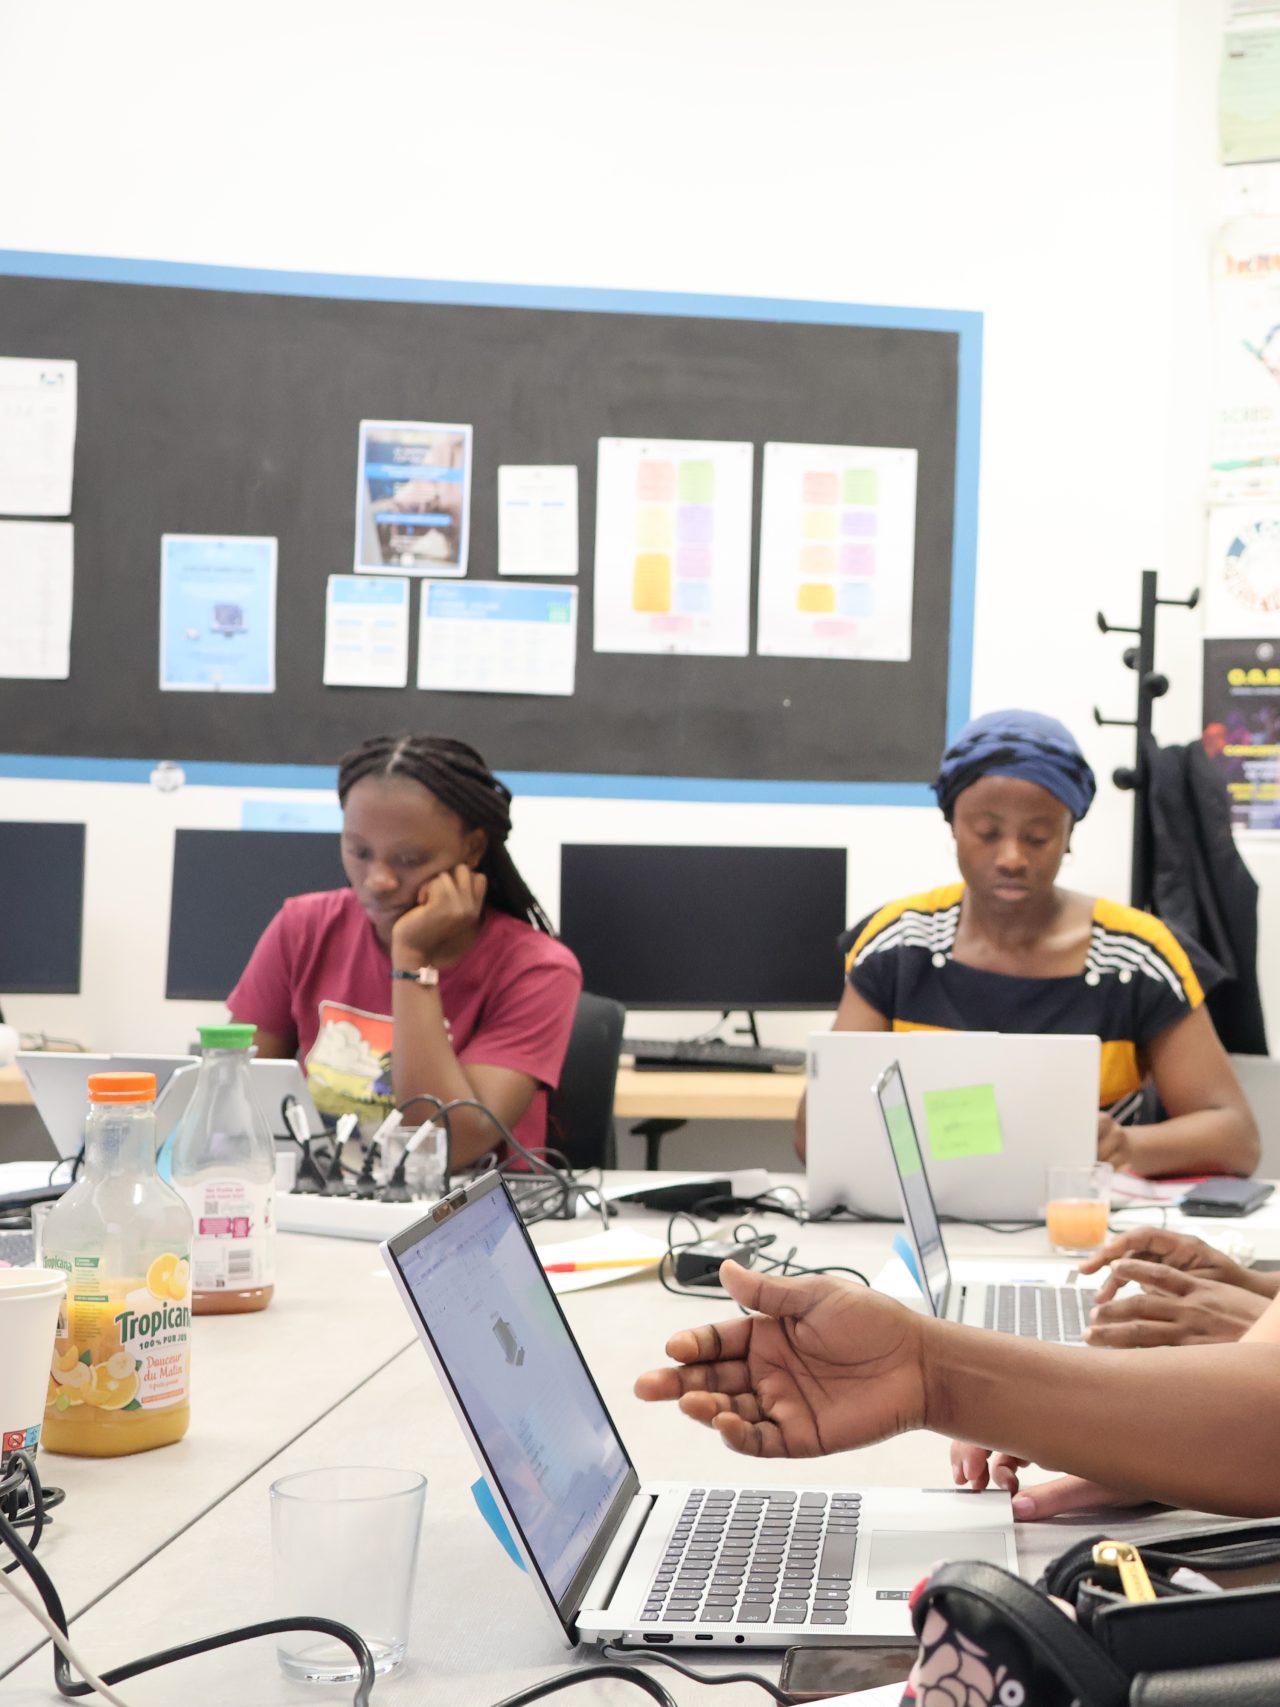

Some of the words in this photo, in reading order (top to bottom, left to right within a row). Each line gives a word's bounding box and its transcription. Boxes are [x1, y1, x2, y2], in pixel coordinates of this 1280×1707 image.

[114, 1301, 191, 1344] Tropican
[163, 1334, 176, 1344] PUR
[145, 1353, 182, 1368] Douceur
[143, 1370, 157, 1381] du
[160, 1364, 183, 1379] Matin
